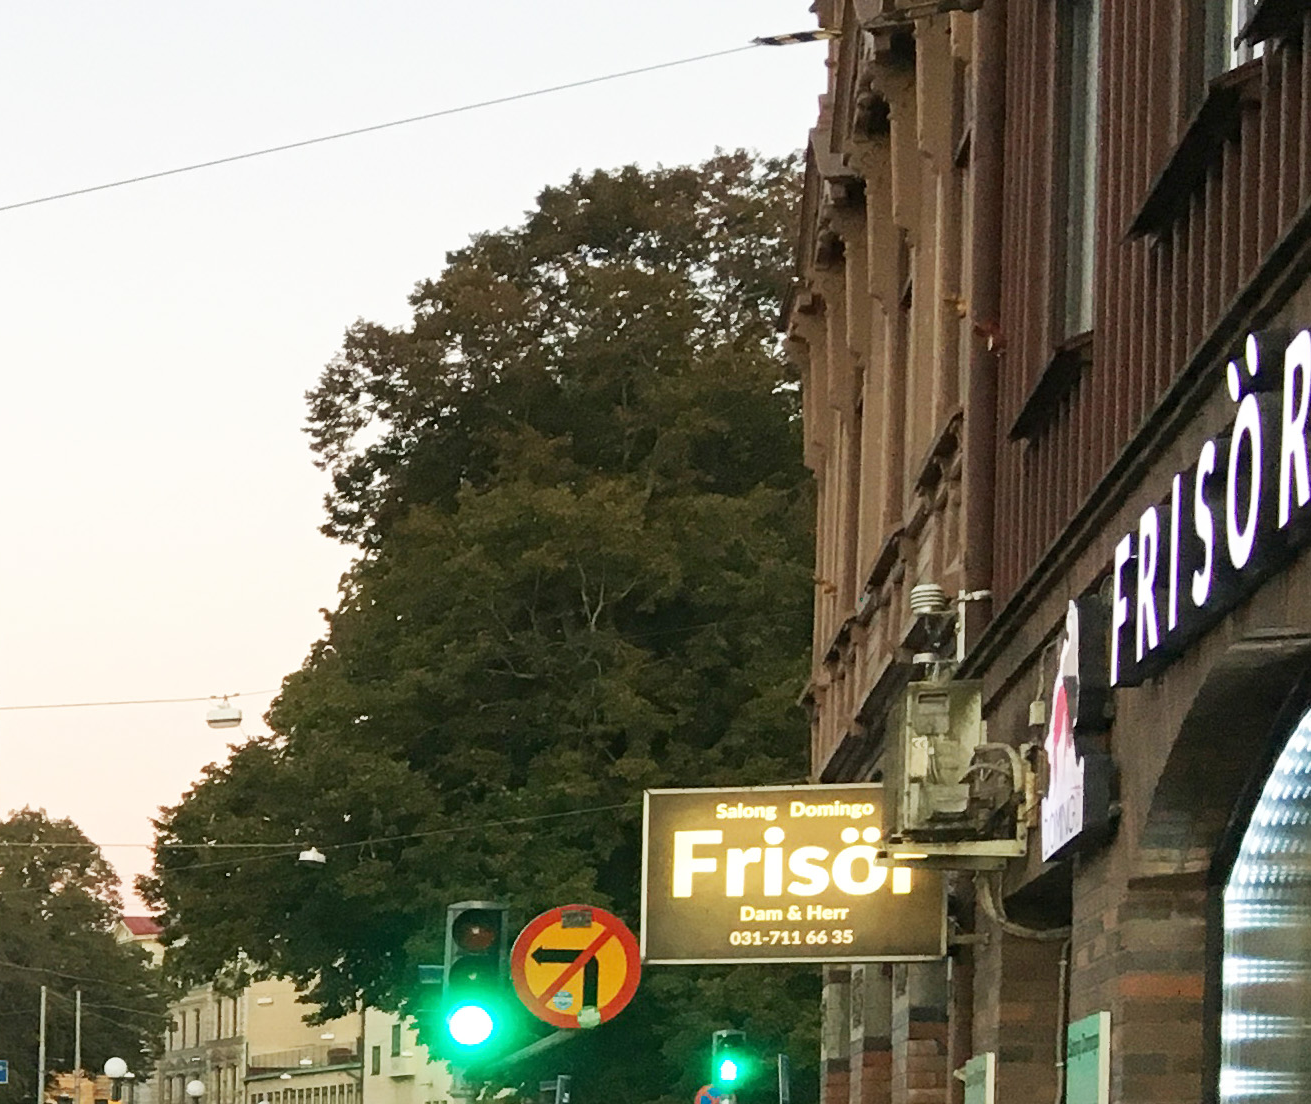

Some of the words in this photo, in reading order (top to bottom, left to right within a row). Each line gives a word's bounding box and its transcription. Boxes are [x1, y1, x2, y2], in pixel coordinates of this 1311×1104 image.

[1110, 329, 1311, 687] FRISÖR
[716, 803, 777, 821] Salong
[790, 801, 875, 819] Domingo
[672, 826, 928, 898] Frisör
[740, 906, 783, 922] Dam
[787, 905, 803, 921] &
[807, 904, 849, 921] Herr
[729, 930, 803, 946] 031-711
[806, 930, 828, 944] 66
[831, 929, 854, 944] 35
